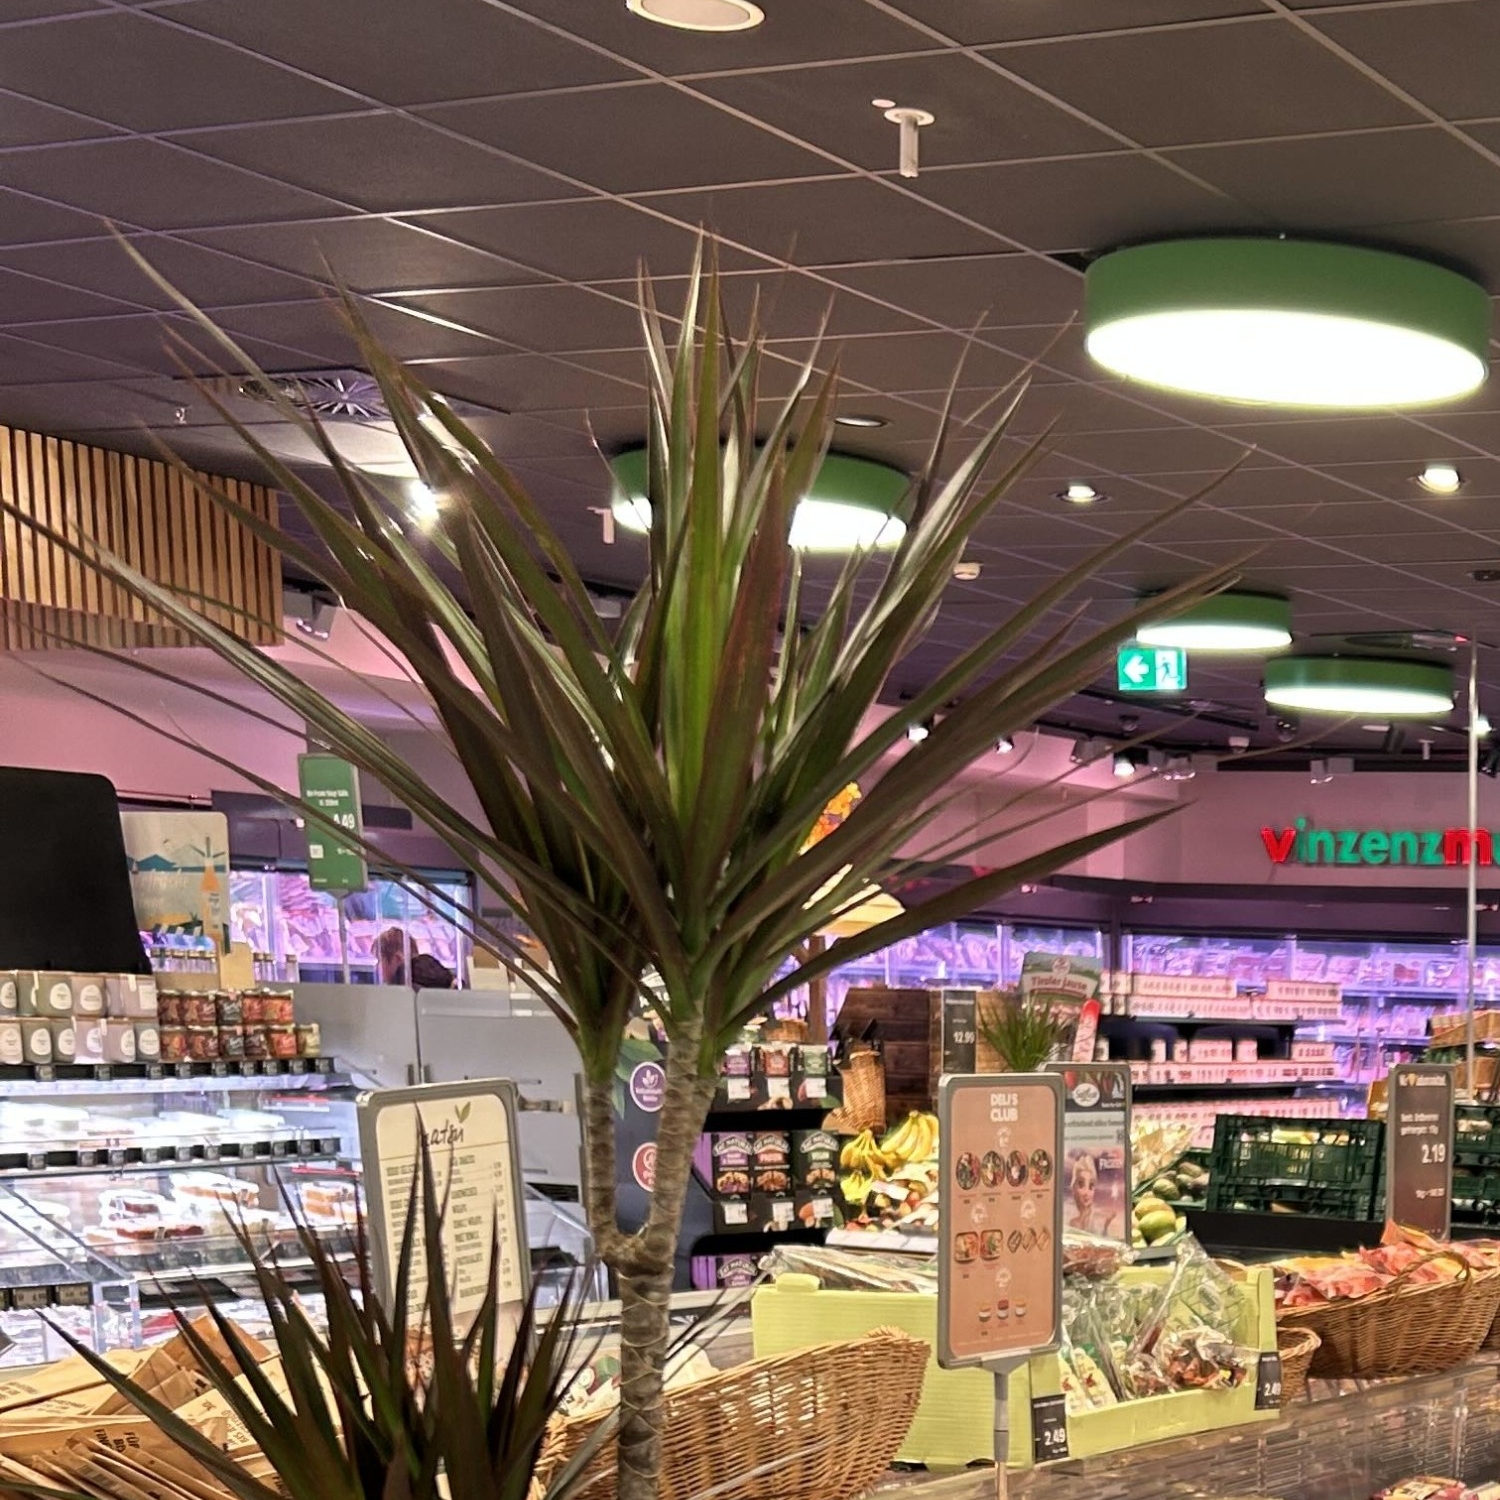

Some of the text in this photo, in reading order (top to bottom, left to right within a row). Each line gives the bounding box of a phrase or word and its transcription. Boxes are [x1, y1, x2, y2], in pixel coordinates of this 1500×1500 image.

[990, 1108, 1019, 1122] CLUB
[1421, 1143, 1446, 1164] 2.19
[1044, 1428, 1066, 1446] 2.49
